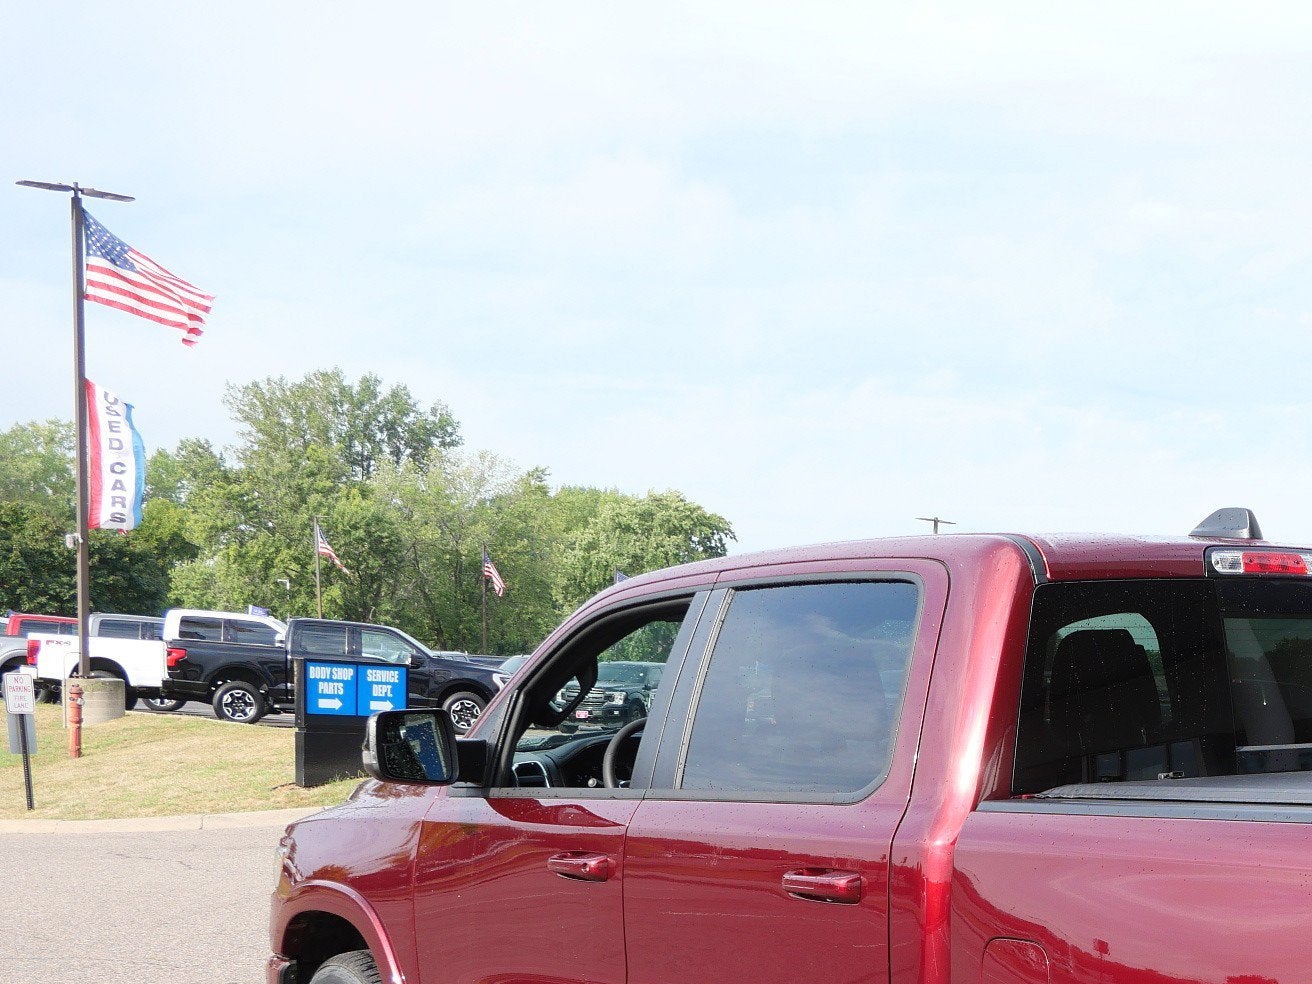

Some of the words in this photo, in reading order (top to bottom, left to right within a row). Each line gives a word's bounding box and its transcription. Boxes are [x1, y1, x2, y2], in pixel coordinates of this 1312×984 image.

[104, 391, 124, 451] USED
[109, 461, 127, 524] CARS
[13, 676, 23, 684] NO
[309, 665, 332, 680] BODY
[332, 666, 354, 681] SHOP
[366, 669, 399, 683] SERVICE
[8, 685, 31, 693] PARKING
[318, 682, 344, 695] PARTS
[372, 683, 393, 698] DEPT.
